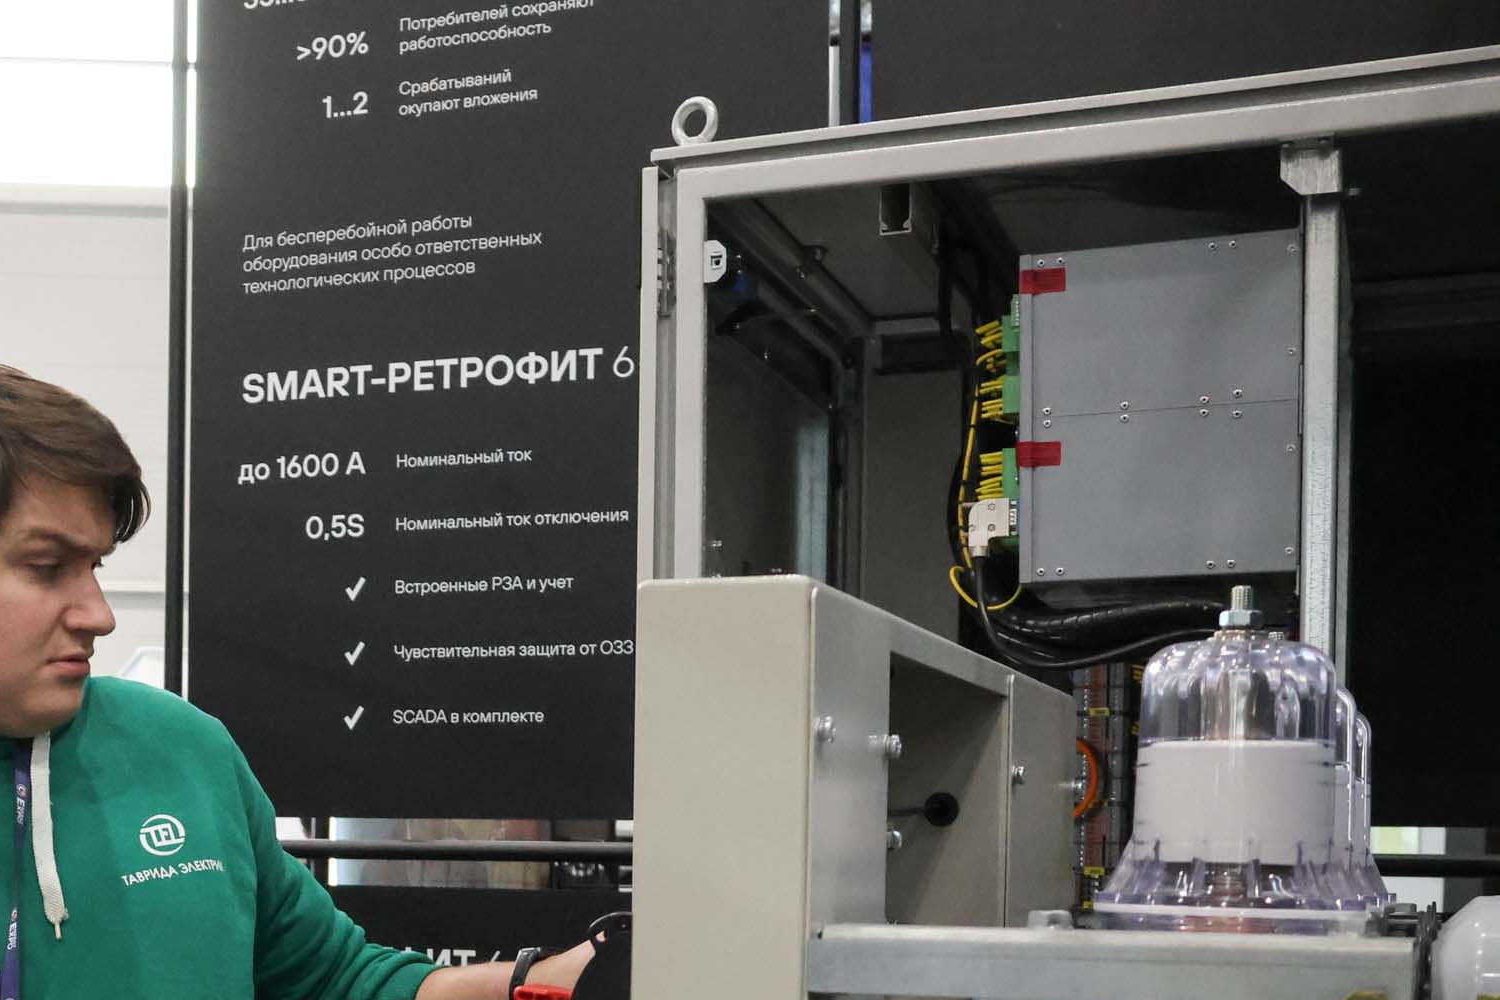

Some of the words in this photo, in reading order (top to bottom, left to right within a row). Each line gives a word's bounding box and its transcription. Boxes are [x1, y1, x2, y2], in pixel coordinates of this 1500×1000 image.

[400, 5, 511, 34] Потребителей
[297, 32, 368, 60] >90%
[400, 21, 551, 55] работоспособность
[399, 69, 511, 96] Срабатываний
[399, 99, 460, 117] окупают
[464, 90, 537, 108] вложения
[243, 235, 273, 252] Для
[277, 219, 410, 250] бесперебойной
[412, 215, 472, 236] работы
[243, 250, 357, 272] оборудования
[361, 242, 411, 260] особо
[415, 233, 541, 255] ответственных
[243, 271, 379, 293] технологических
[384, 262, 475, 283] процессов
[243, 348, 603, 403] SMART-РЕТРОФИТ
[613, 346, 634, 377] 6
[238, 463, 270, 484] до
[277, 453, 339, 478] 1600
[397, 449, 503, 467] Номинальный
[507, 450, 532, 461] ток
[306, 514, 364, 540] 0,5S
[396, 513, 503, 530] Номинальный
[506, 515, 531, 526] ток
[535, 511, 628, 525] отключения
[395, 580, 488, 596] Встроенные
[527, 579, 536, 589] и
[539, 578, 574, 592] учет
[394, 645, 515, 662] Чувствительная
[519, 645, 575, 657] защита
[580, 644, 597, 655] от
[393, 709, 447, 724] SCADA
[451, 713, 459, 723] в
[463, 712, 544, 723] комплекте
[121, 865, 179, 886] ТАВРИДА
[178, 859, 224, 874] ЭЛЕКТРИ
